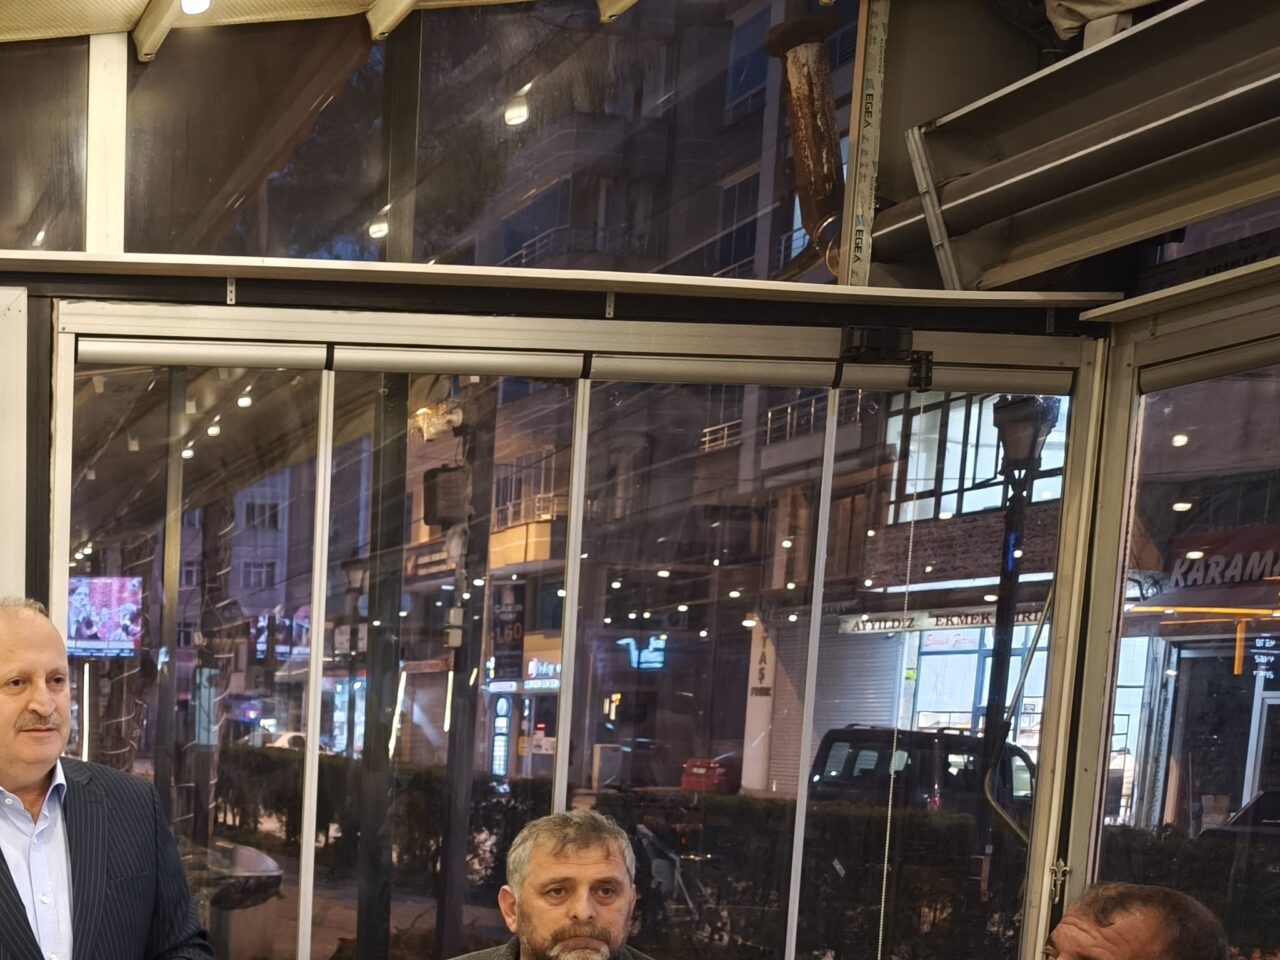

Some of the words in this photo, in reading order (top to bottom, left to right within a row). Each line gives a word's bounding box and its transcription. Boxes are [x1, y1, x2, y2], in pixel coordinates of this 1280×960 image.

[863, 93, 874, 128] EGEA
[852, 229, 864, 263] EGEA
[934, 612, 993, 627] EKMEK
